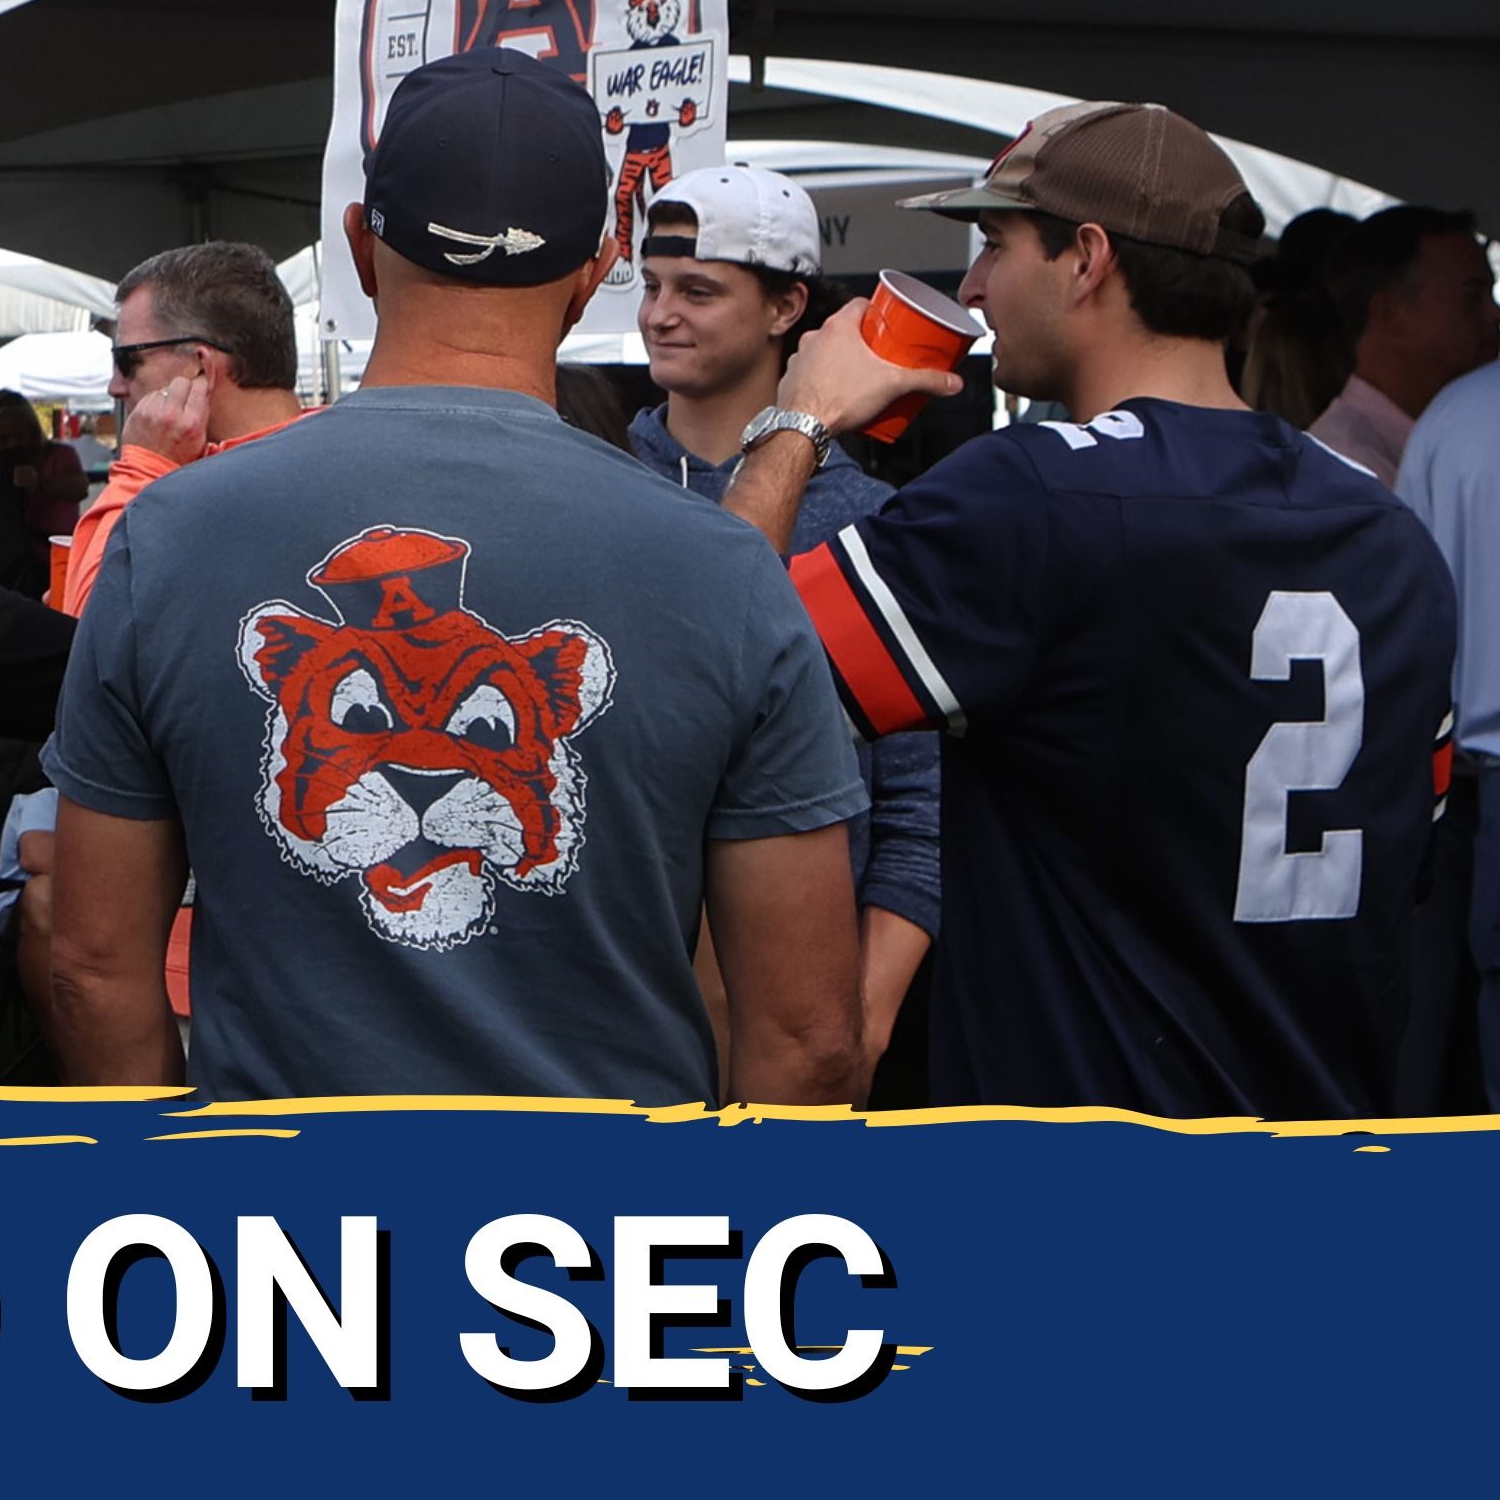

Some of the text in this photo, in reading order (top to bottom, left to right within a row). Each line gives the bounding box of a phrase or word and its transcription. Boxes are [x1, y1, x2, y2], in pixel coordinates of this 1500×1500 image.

[387, 32, 419, 59] EST.
[606, 49, 706, 98] WAR EAGLE!
[371, 576, 436, 628] A
[1233, 589, 1365, 922] 2
